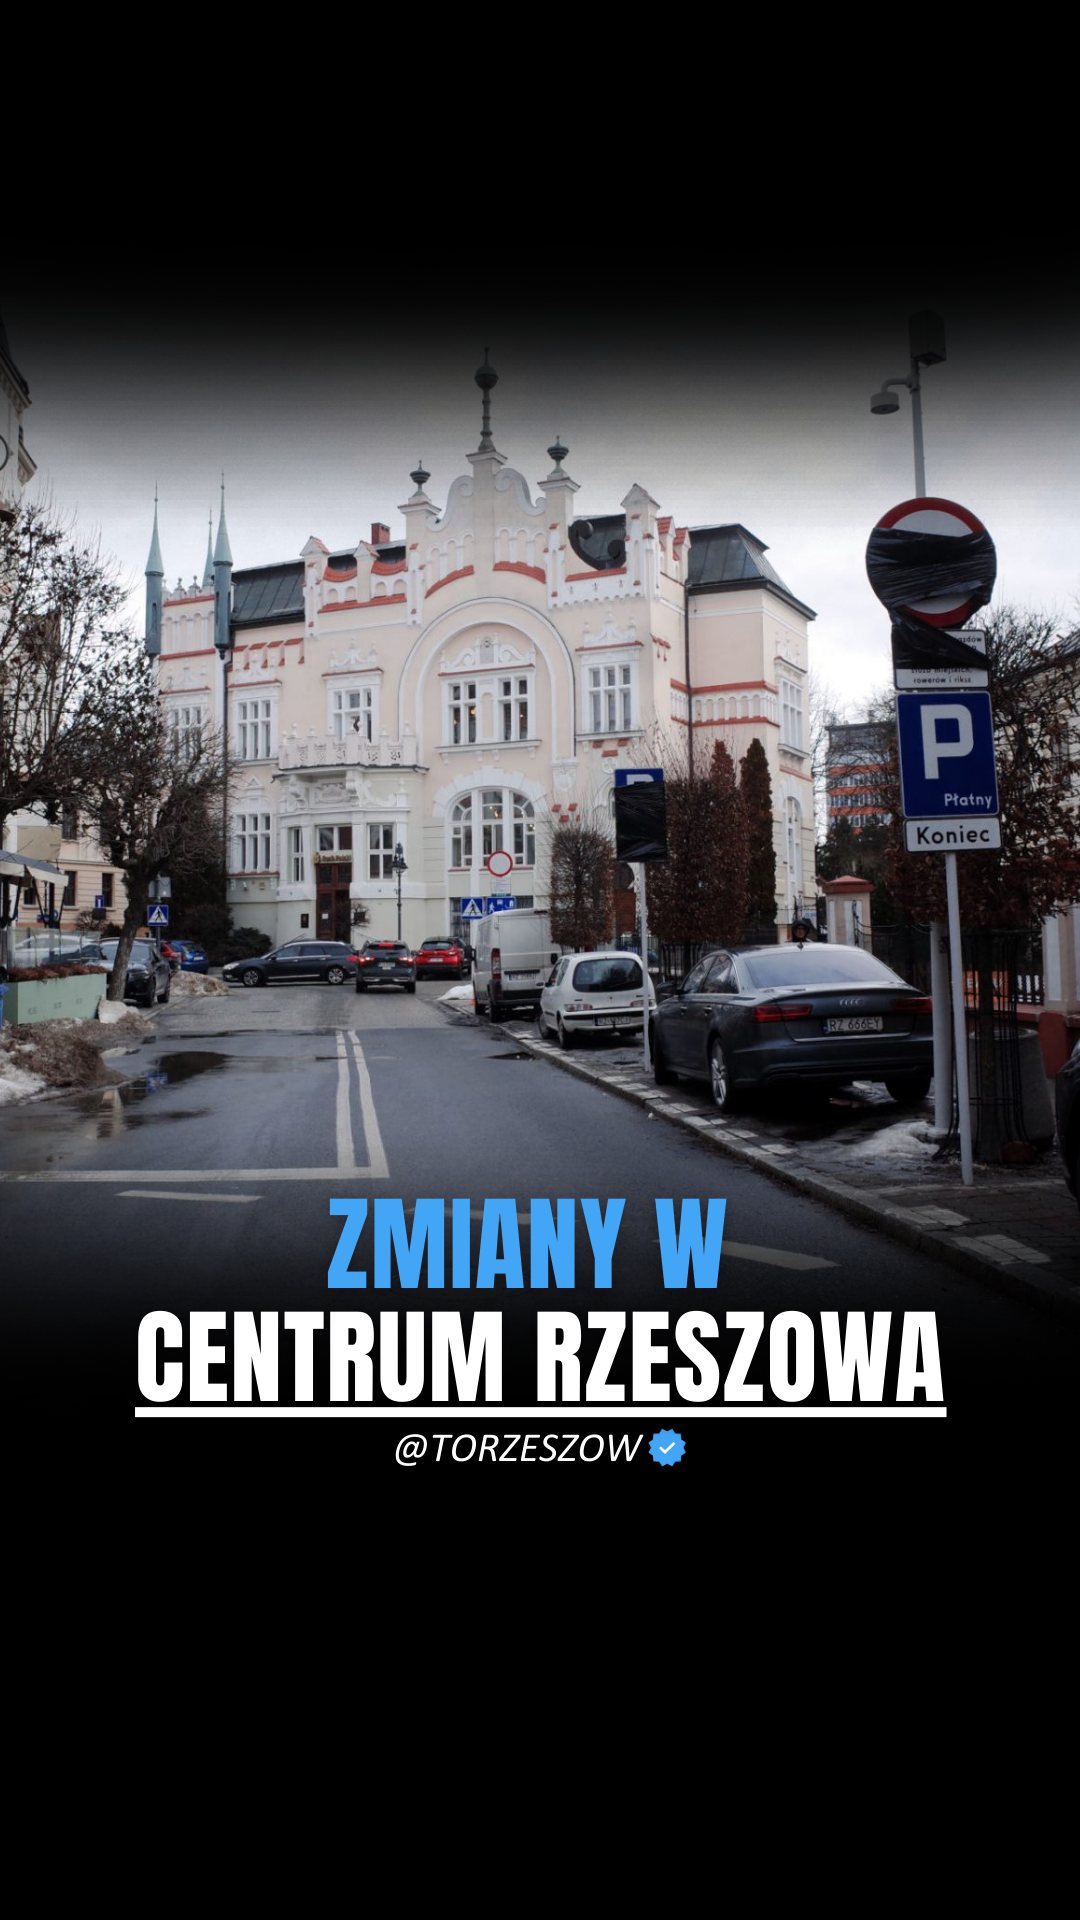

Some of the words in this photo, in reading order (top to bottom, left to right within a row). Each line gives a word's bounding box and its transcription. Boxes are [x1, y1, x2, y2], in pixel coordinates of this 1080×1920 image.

[920, 705, 974, 779] P
[945, 793, 992, 809] Płatny
[917, 825, 990, 845] Koniec
[830, 1018, 844, 1032] RZ
[848, 1016, 880, 1030] 666EY
